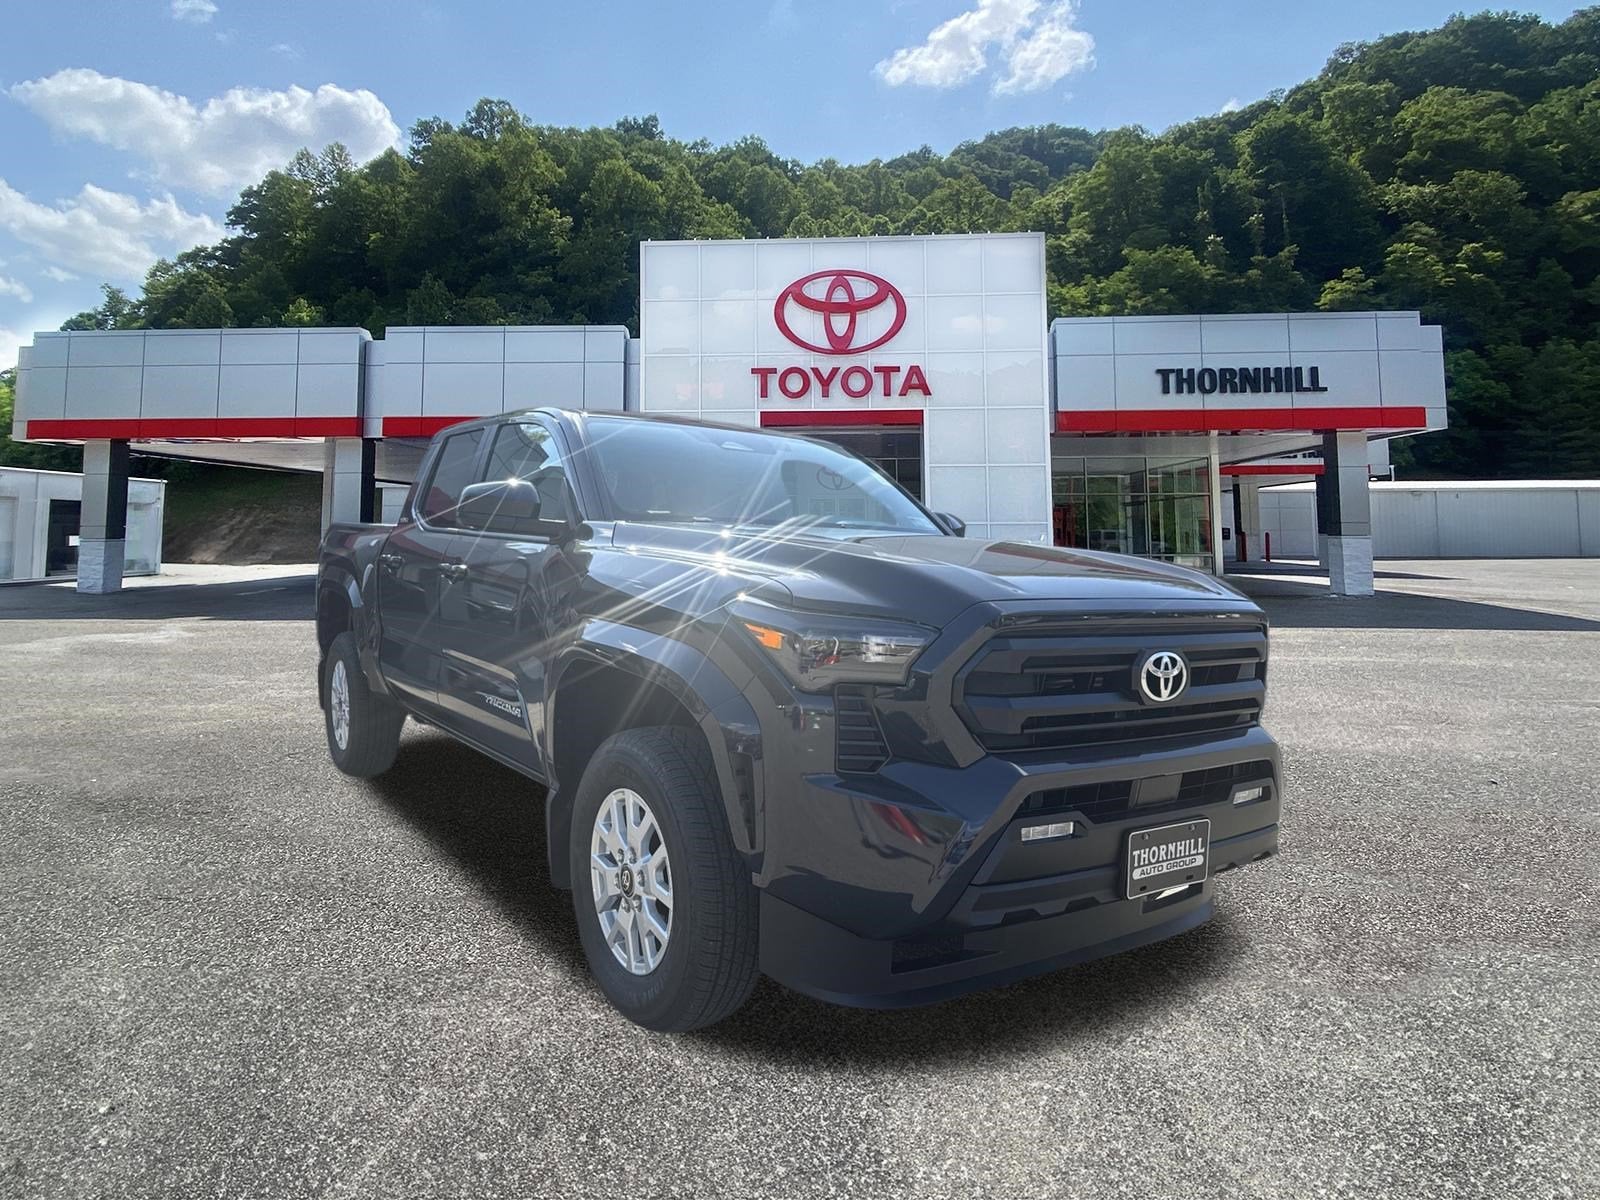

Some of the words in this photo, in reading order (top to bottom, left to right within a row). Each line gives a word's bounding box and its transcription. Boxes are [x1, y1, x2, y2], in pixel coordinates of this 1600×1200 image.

[751, 365, 932, 399] TOYOTA
[1155, 366, 1328, 394] THORNHILL
[1132, 837, 1205, 867] THORNHILL
[1139, 864, 1164, 877] AUTO
[1166, 857, 1197, 871] GROUP
